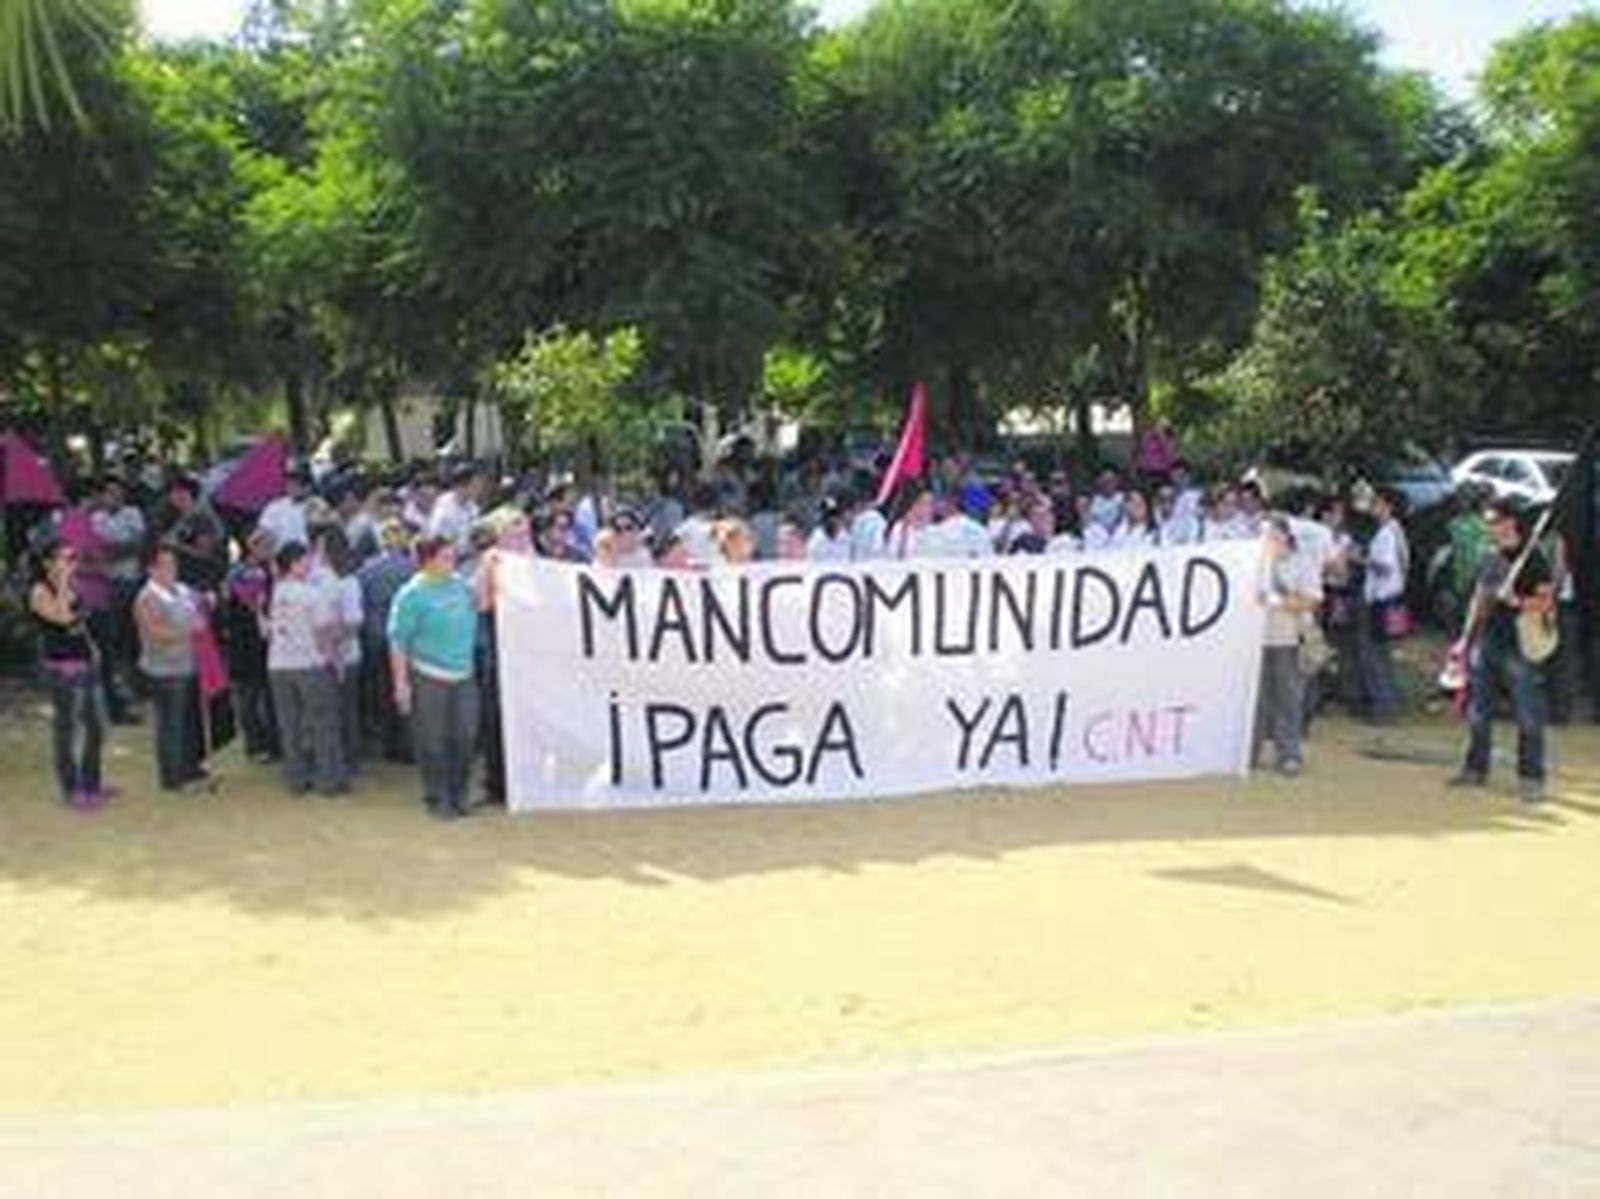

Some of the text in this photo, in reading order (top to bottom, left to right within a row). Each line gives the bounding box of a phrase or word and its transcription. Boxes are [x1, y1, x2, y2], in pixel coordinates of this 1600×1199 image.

[578, 557, 1229, 664] MANCOMUNIDAD
[946, 691, 1067, 771] YA!
[1083, 704, 1198, 764] CNT
